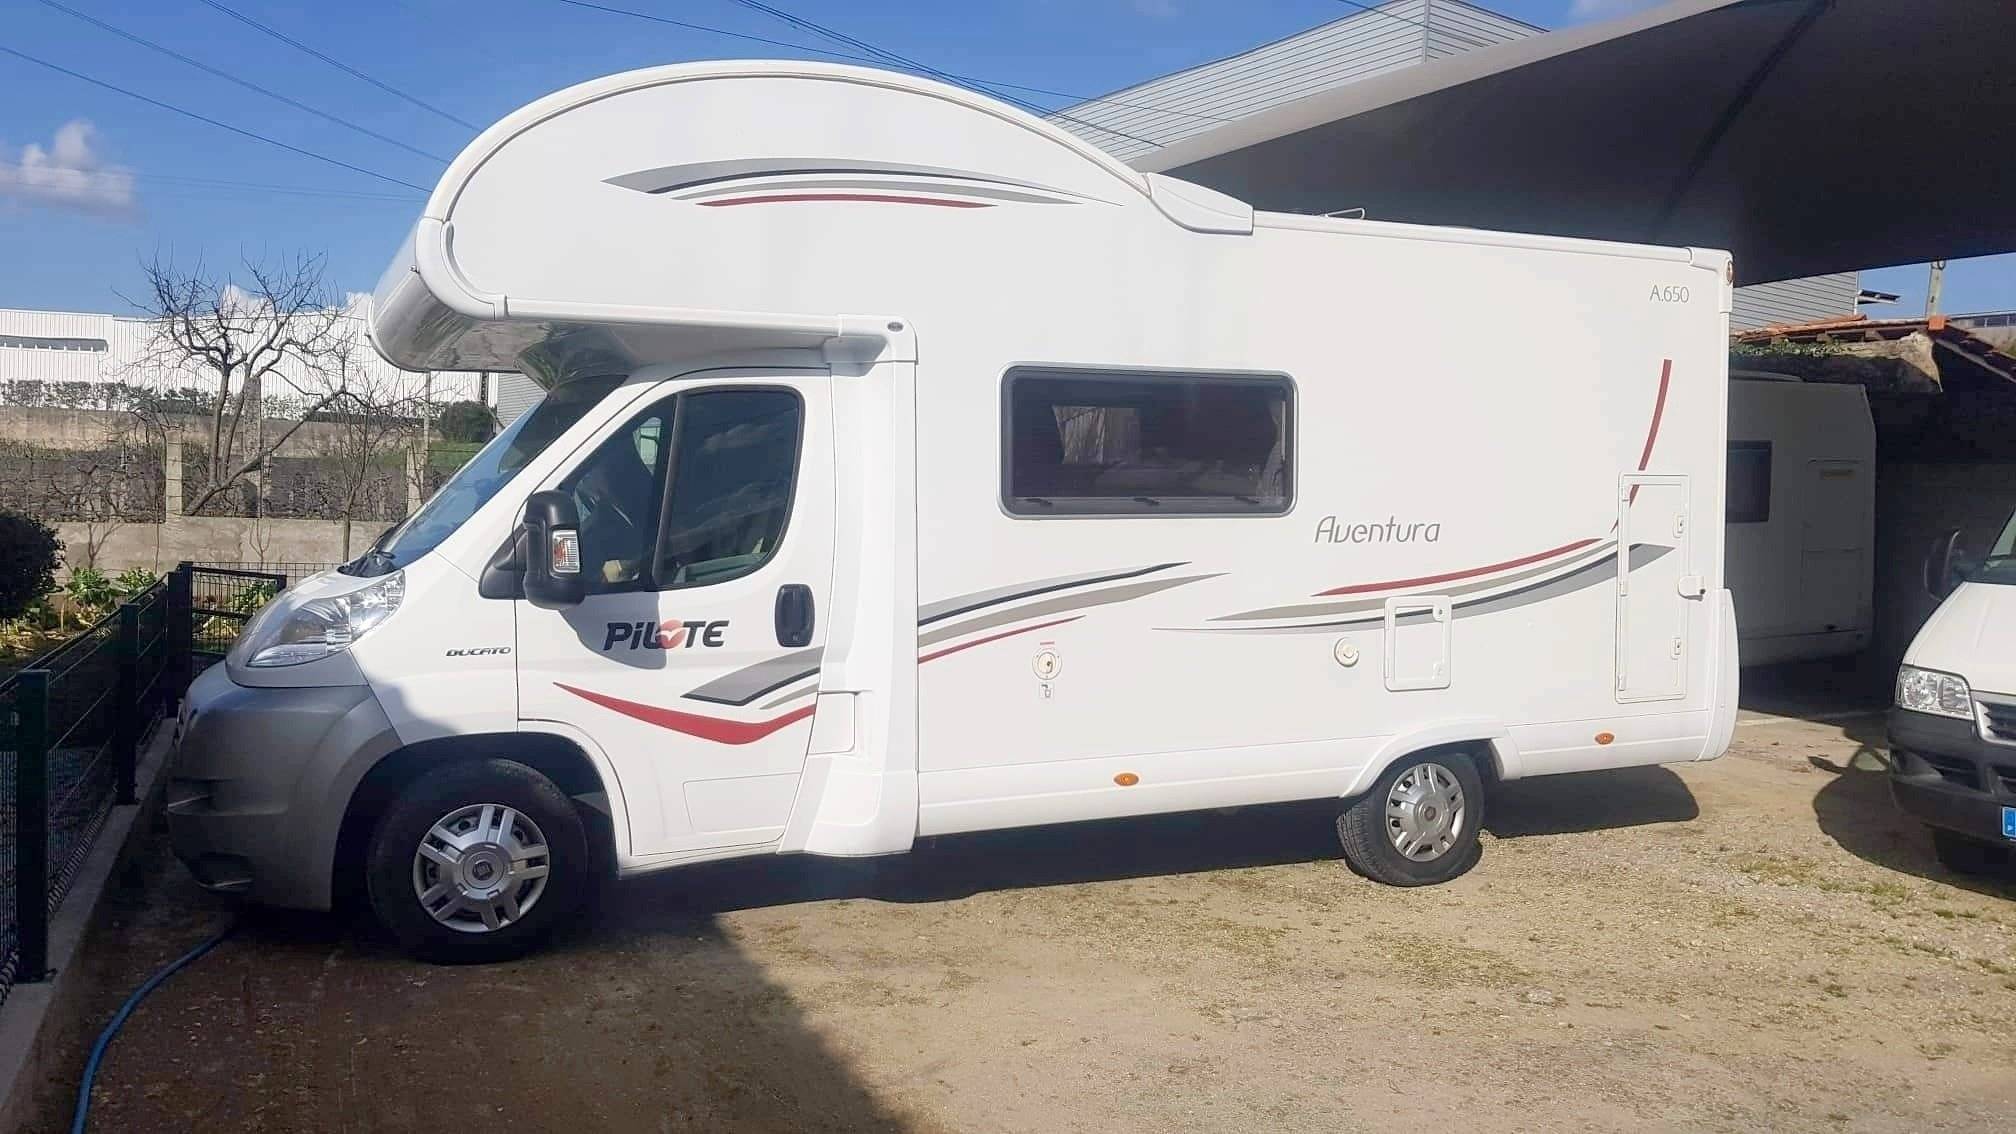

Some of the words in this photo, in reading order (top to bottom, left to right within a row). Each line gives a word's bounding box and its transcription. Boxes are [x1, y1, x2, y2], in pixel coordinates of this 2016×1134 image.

[1649, 284, 1690, 303] A.650
[1315, 515, 1441, 543] Aventura
[446, 646, 512, 657] DUCATO
